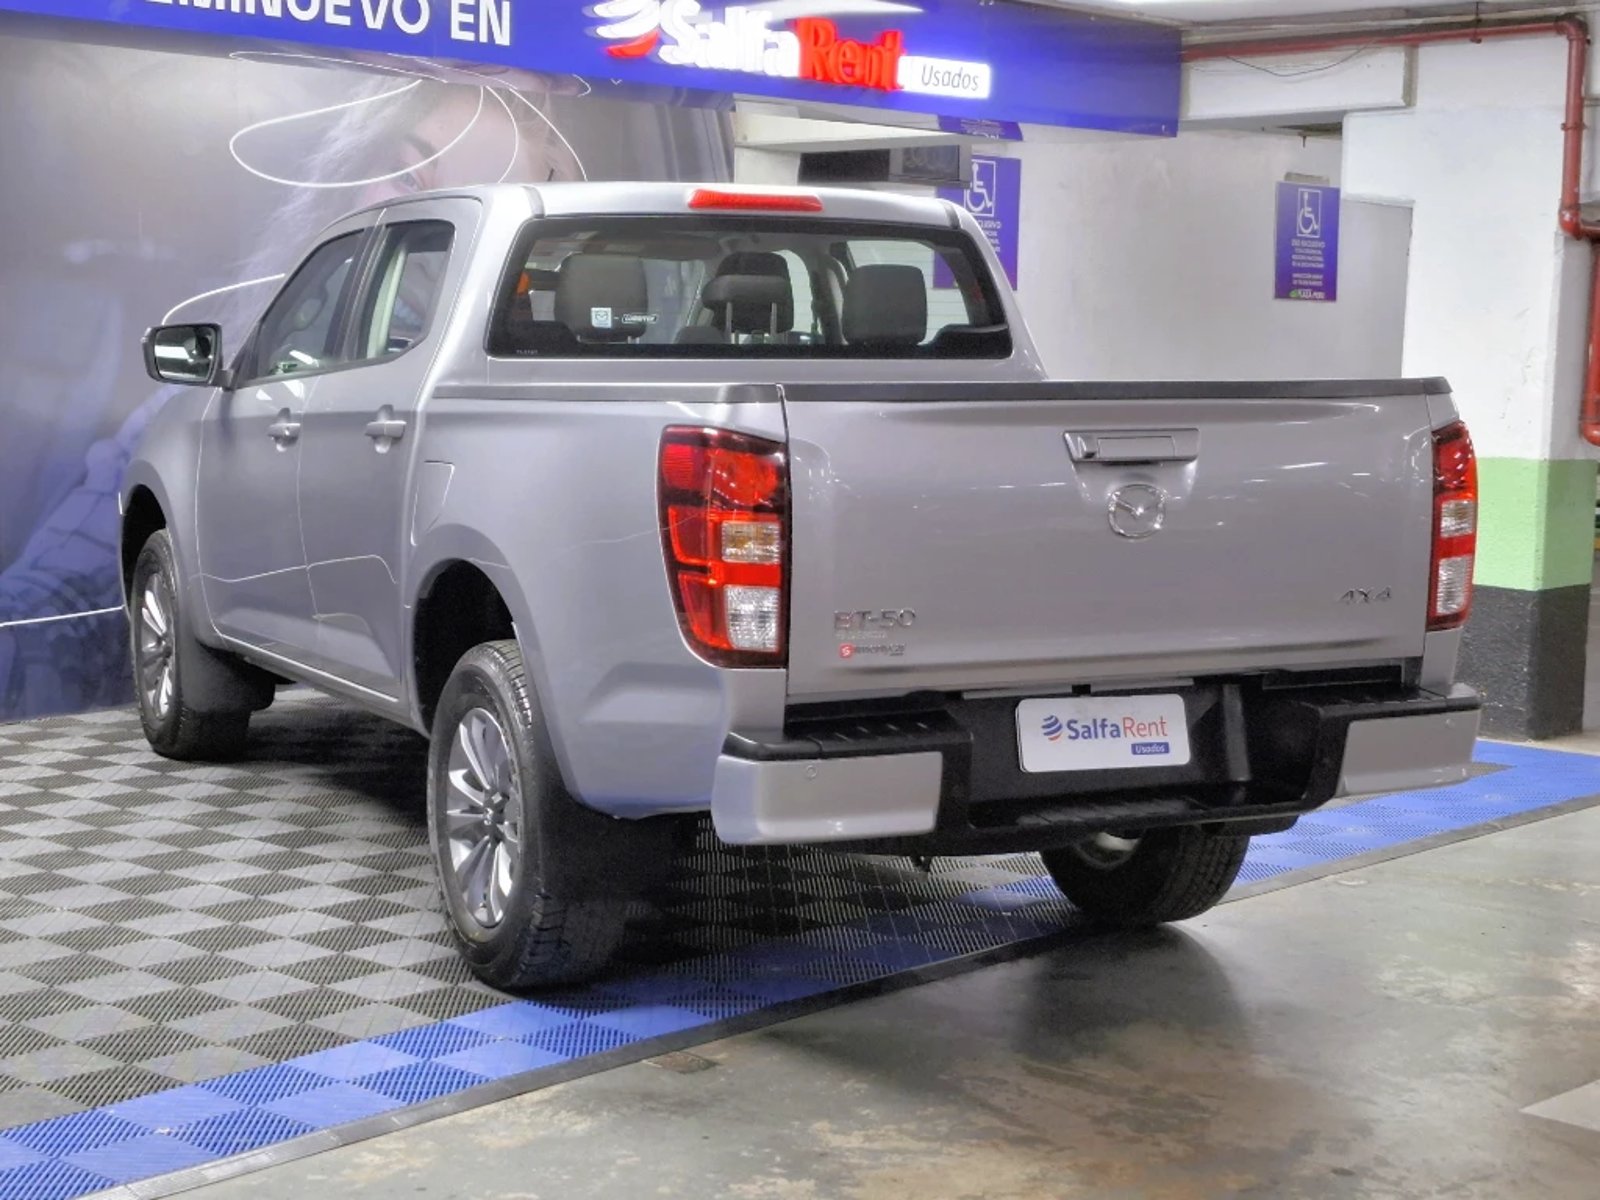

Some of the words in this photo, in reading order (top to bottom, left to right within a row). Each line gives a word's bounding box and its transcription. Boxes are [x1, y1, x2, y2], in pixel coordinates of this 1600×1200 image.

[451, 0, 510, 46] EN
[921, 64, 980, 92] Usados
[833, 607, 917, 629] BT-50
[1066, 715, 1168, 741] SalfaRent
[1135, 742, 1165, 754] Usados
